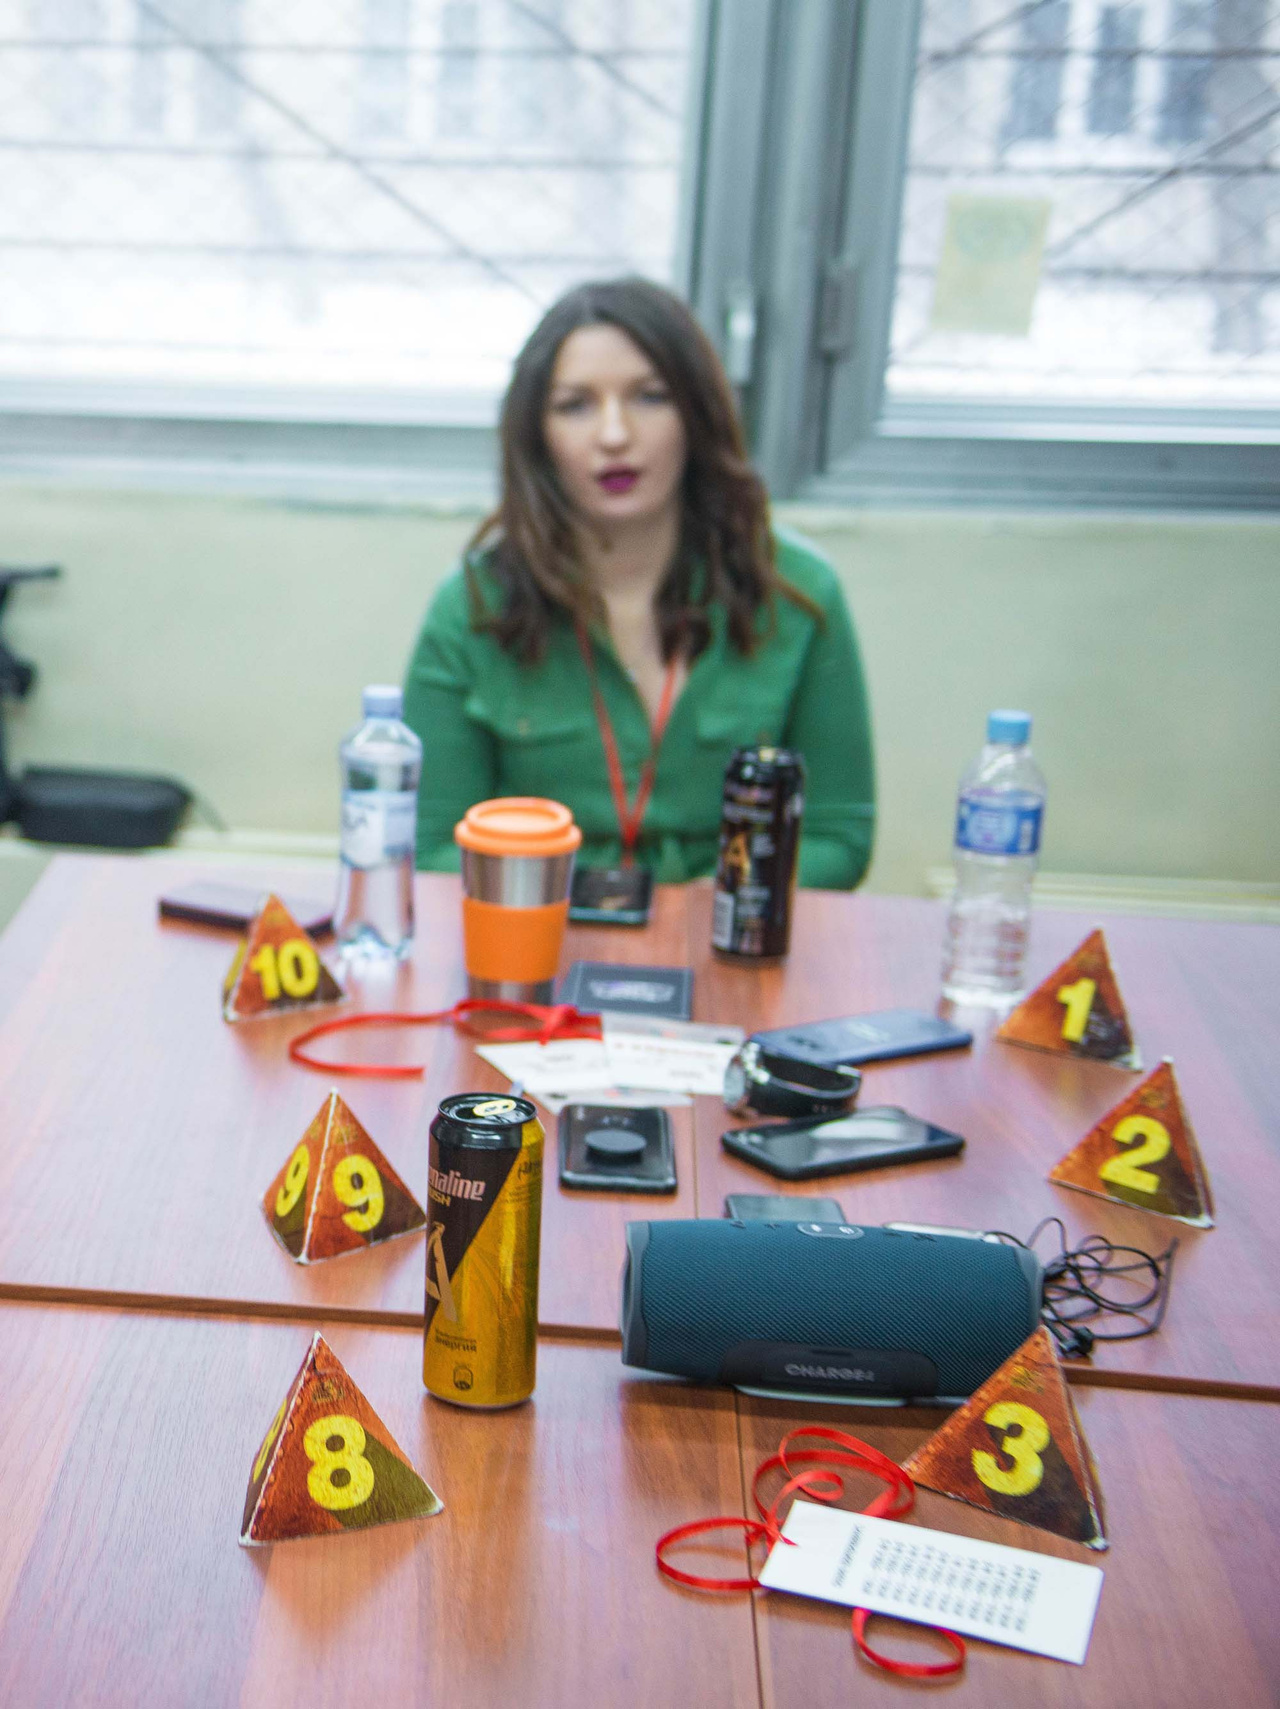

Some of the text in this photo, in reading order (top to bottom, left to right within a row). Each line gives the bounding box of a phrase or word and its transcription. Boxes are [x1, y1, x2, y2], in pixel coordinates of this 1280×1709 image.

[251, 939, 319, 1000] 10
[1057, 977, 1096, 1042] 1
[275, 1144, 310, 1217] 9
[429, 1166, 486, 1201] naline
[1098, 1115, 1170, 1194] 2
[332, 1154, 384, 1232] 9
[303, 1414, 375, 1511] 8
[972, 1401, 1051, 1496] 3
